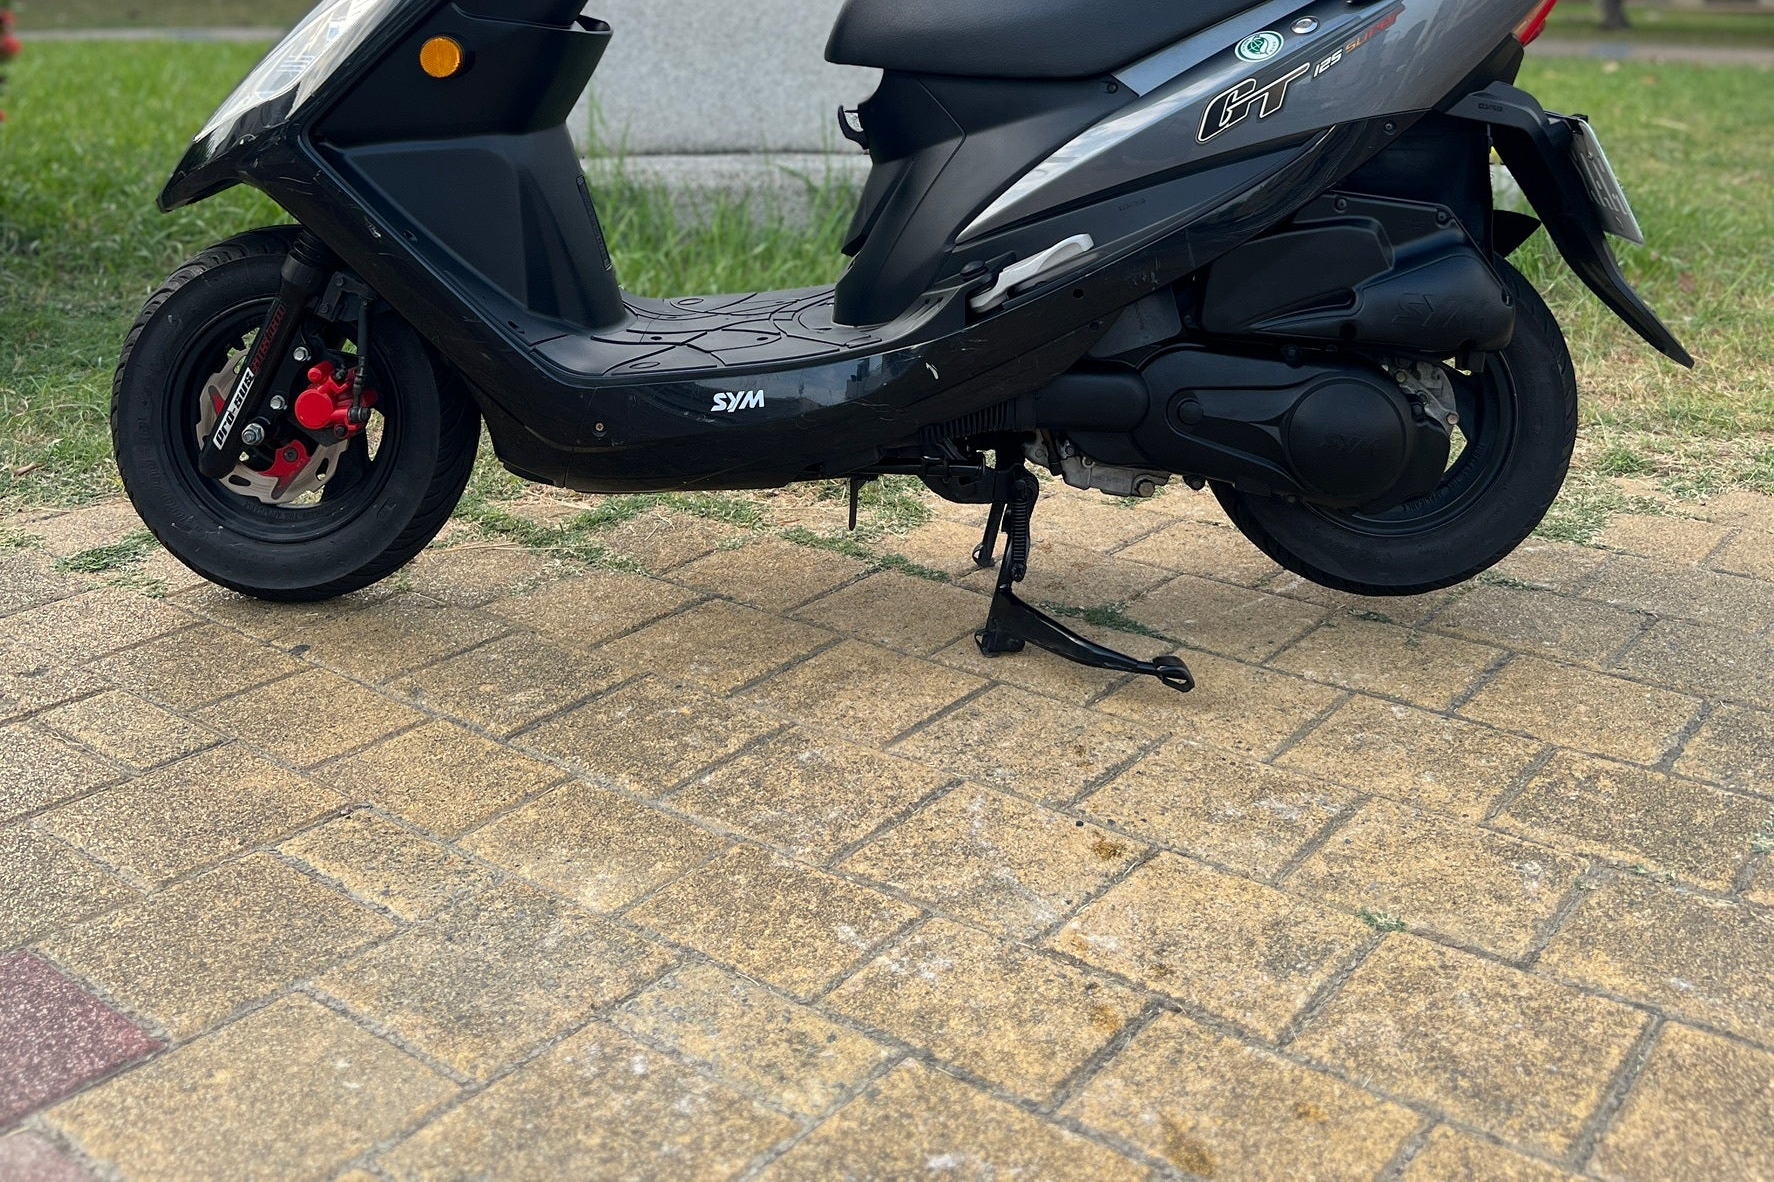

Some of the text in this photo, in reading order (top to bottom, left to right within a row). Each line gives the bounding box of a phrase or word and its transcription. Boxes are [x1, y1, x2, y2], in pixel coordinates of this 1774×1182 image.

[1197, 62, 1311, 142] GT
[1313, 48, 1343, 78] 125
[711, 389, 765, 413] SYM
